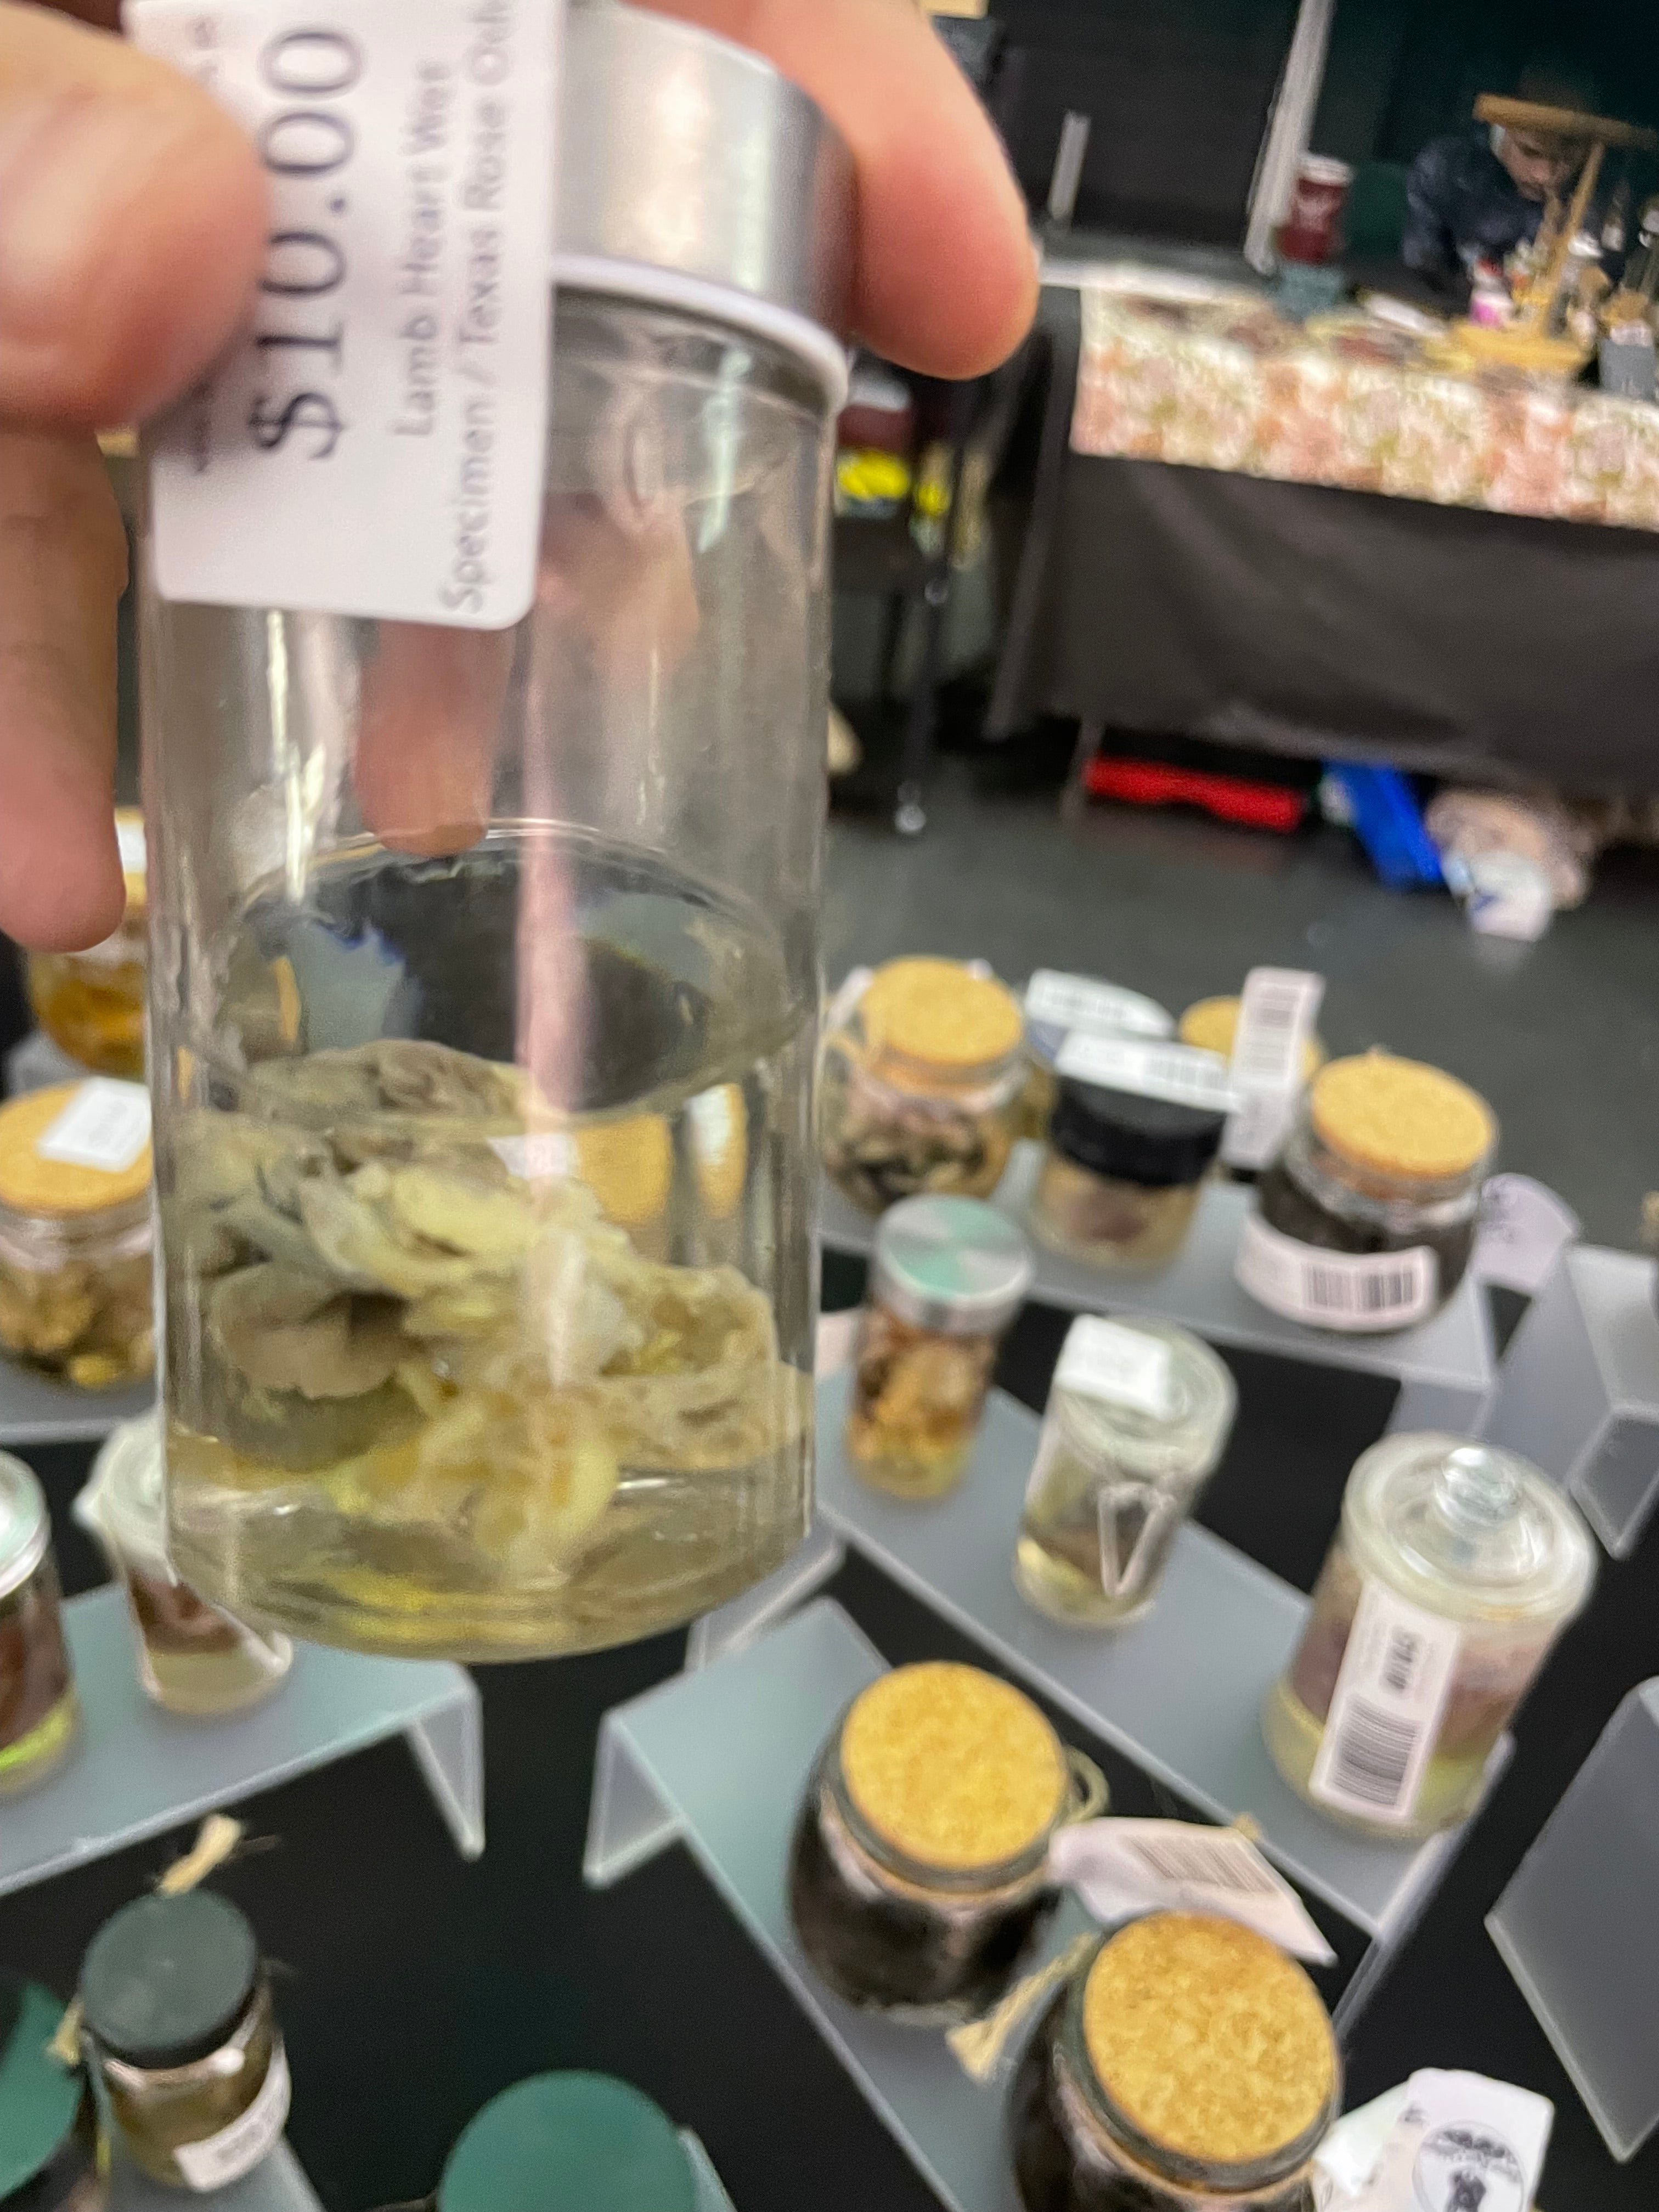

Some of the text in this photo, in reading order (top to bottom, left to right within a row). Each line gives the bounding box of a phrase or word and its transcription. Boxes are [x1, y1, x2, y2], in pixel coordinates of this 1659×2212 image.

[461, 102, 509, 210] Rose
[245, 28, 363, 460] $10.00
[399, 167, 442, 296] Heart
[455, 228, 500, 347] Texas
[392, 314, 437, 437] Lamb
[439, 400, 497, 613] Specimen
